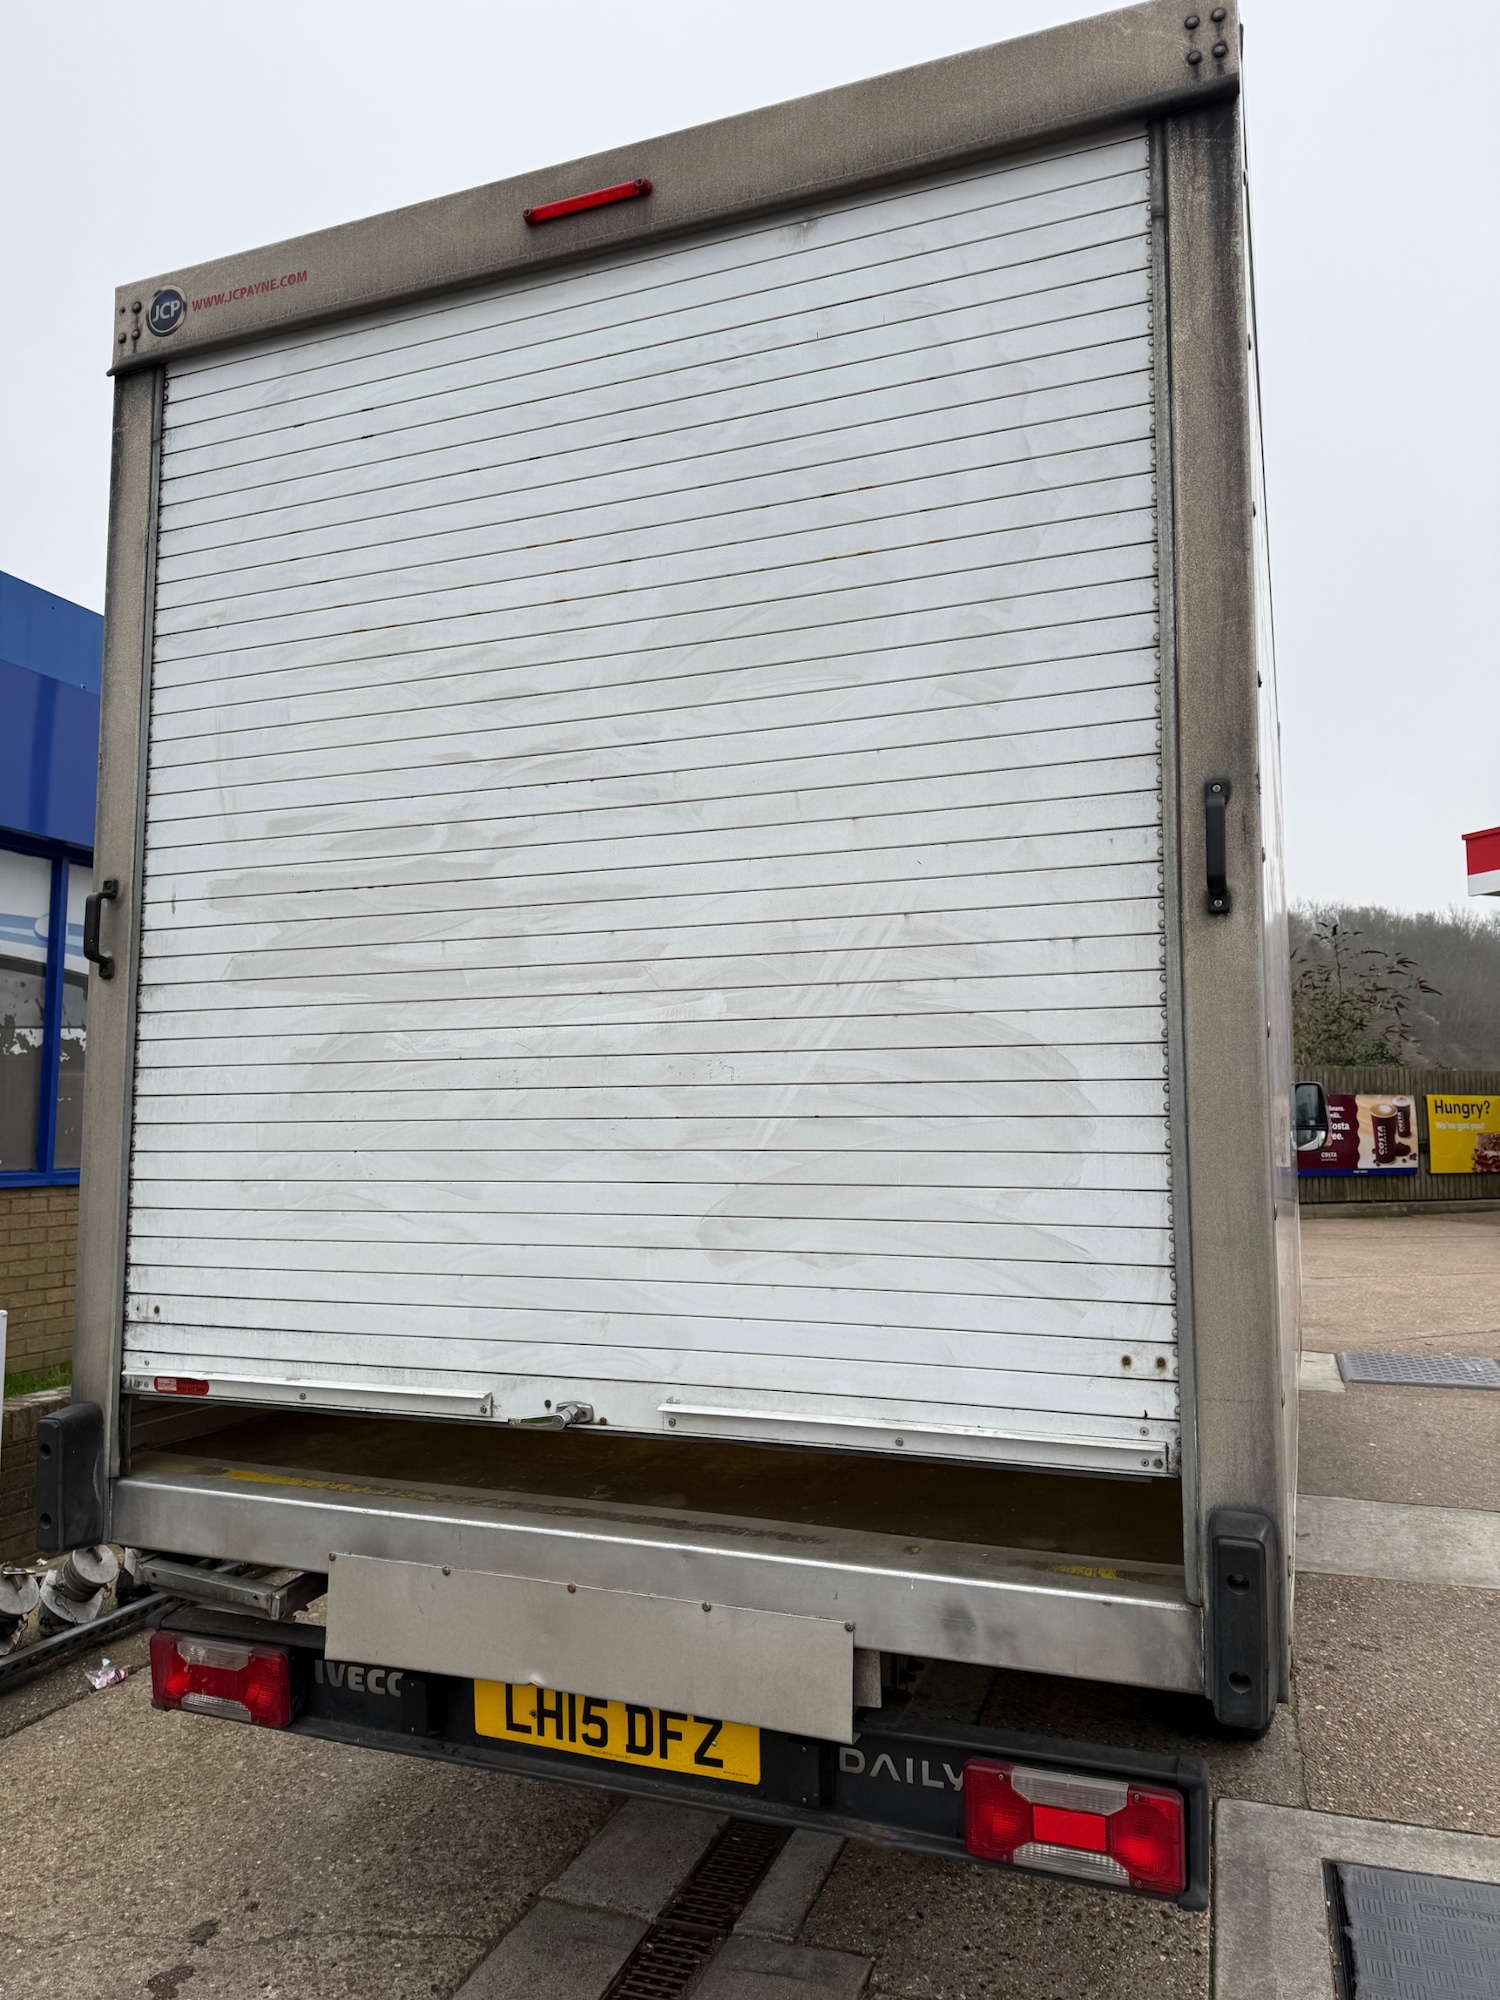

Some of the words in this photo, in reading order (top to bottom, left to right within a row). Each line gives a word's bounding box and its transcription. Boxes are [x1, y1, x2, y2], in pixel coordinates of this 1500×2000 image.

[192, 270, 307, 312] WWW.JCPAYNE.COM
[152, 301, 181, 323] JCP
[1434, 1099, 1491, 1119] Hungry?
[1331, 1122, 1350, 1130] osta
[1377, 1126, 1385, 1155] COSTA
[625, 1703, 724, 1768] DFZ
[839, 1747, 963, 1791] DAILY
